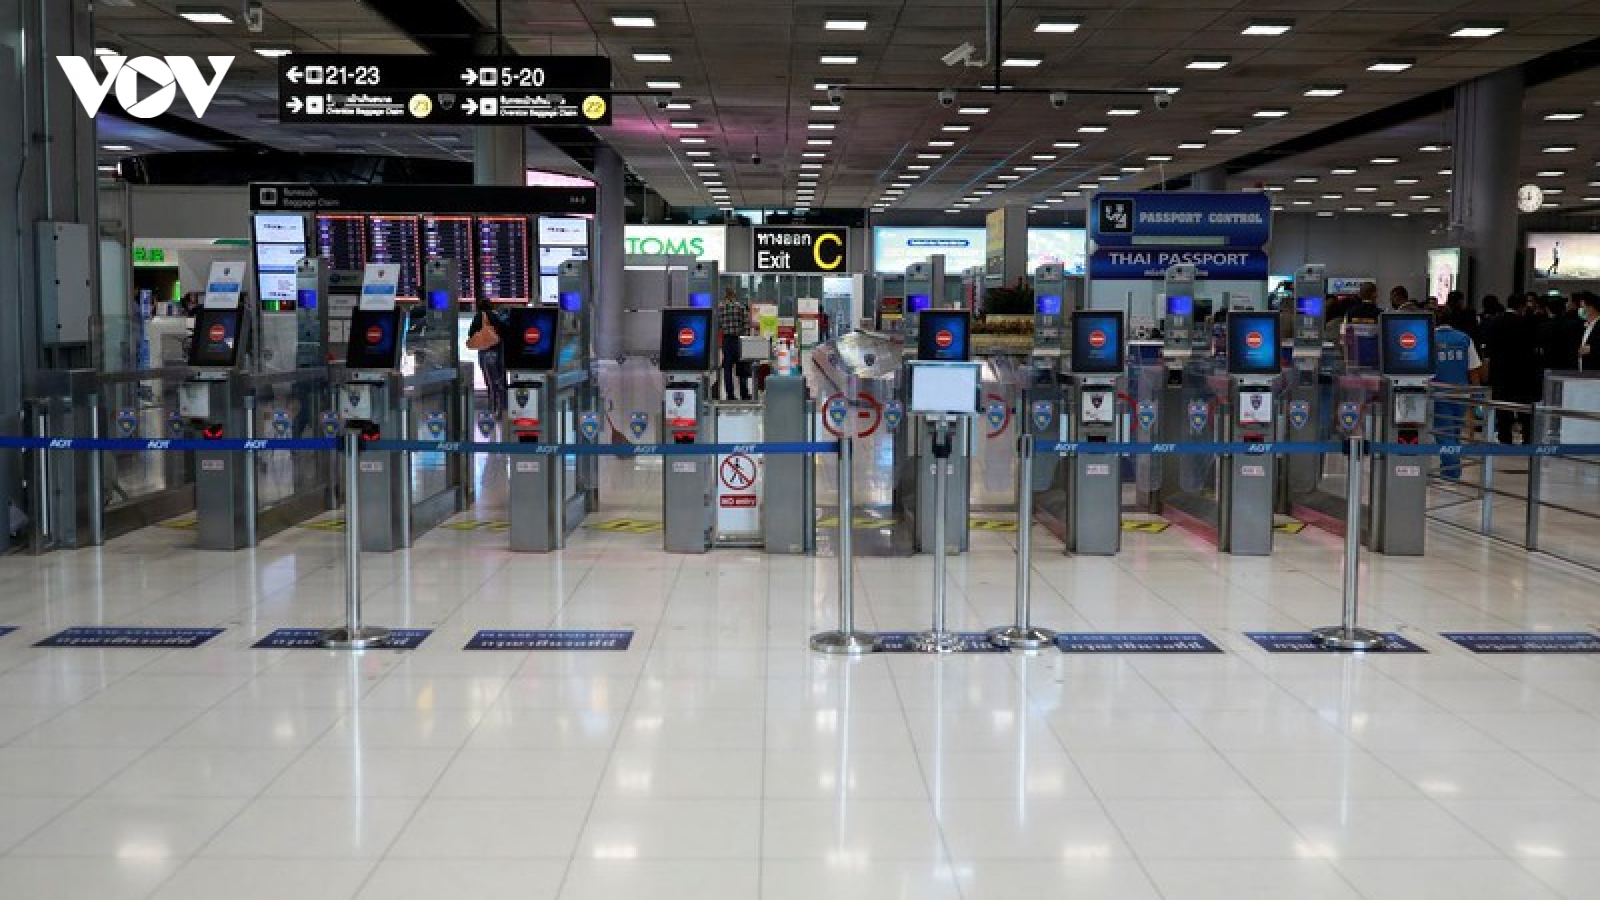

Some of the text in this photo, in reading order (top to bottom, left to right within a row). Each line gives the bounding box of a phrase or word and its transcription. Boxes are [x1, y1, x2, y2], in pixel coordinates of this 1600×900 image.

[325, 66, 381, 85] 21-23
[501, 68, 545, 87] 5-20
[1139, 211, 1263, 223] PASSPORT CONTROL
[757, 233, 812, 246] ทางออก
[757, 250, 791, 269] Exit
[813, 232, 843, 270] C
[1108, 253, 1249, 265] THAI PASSPORT
